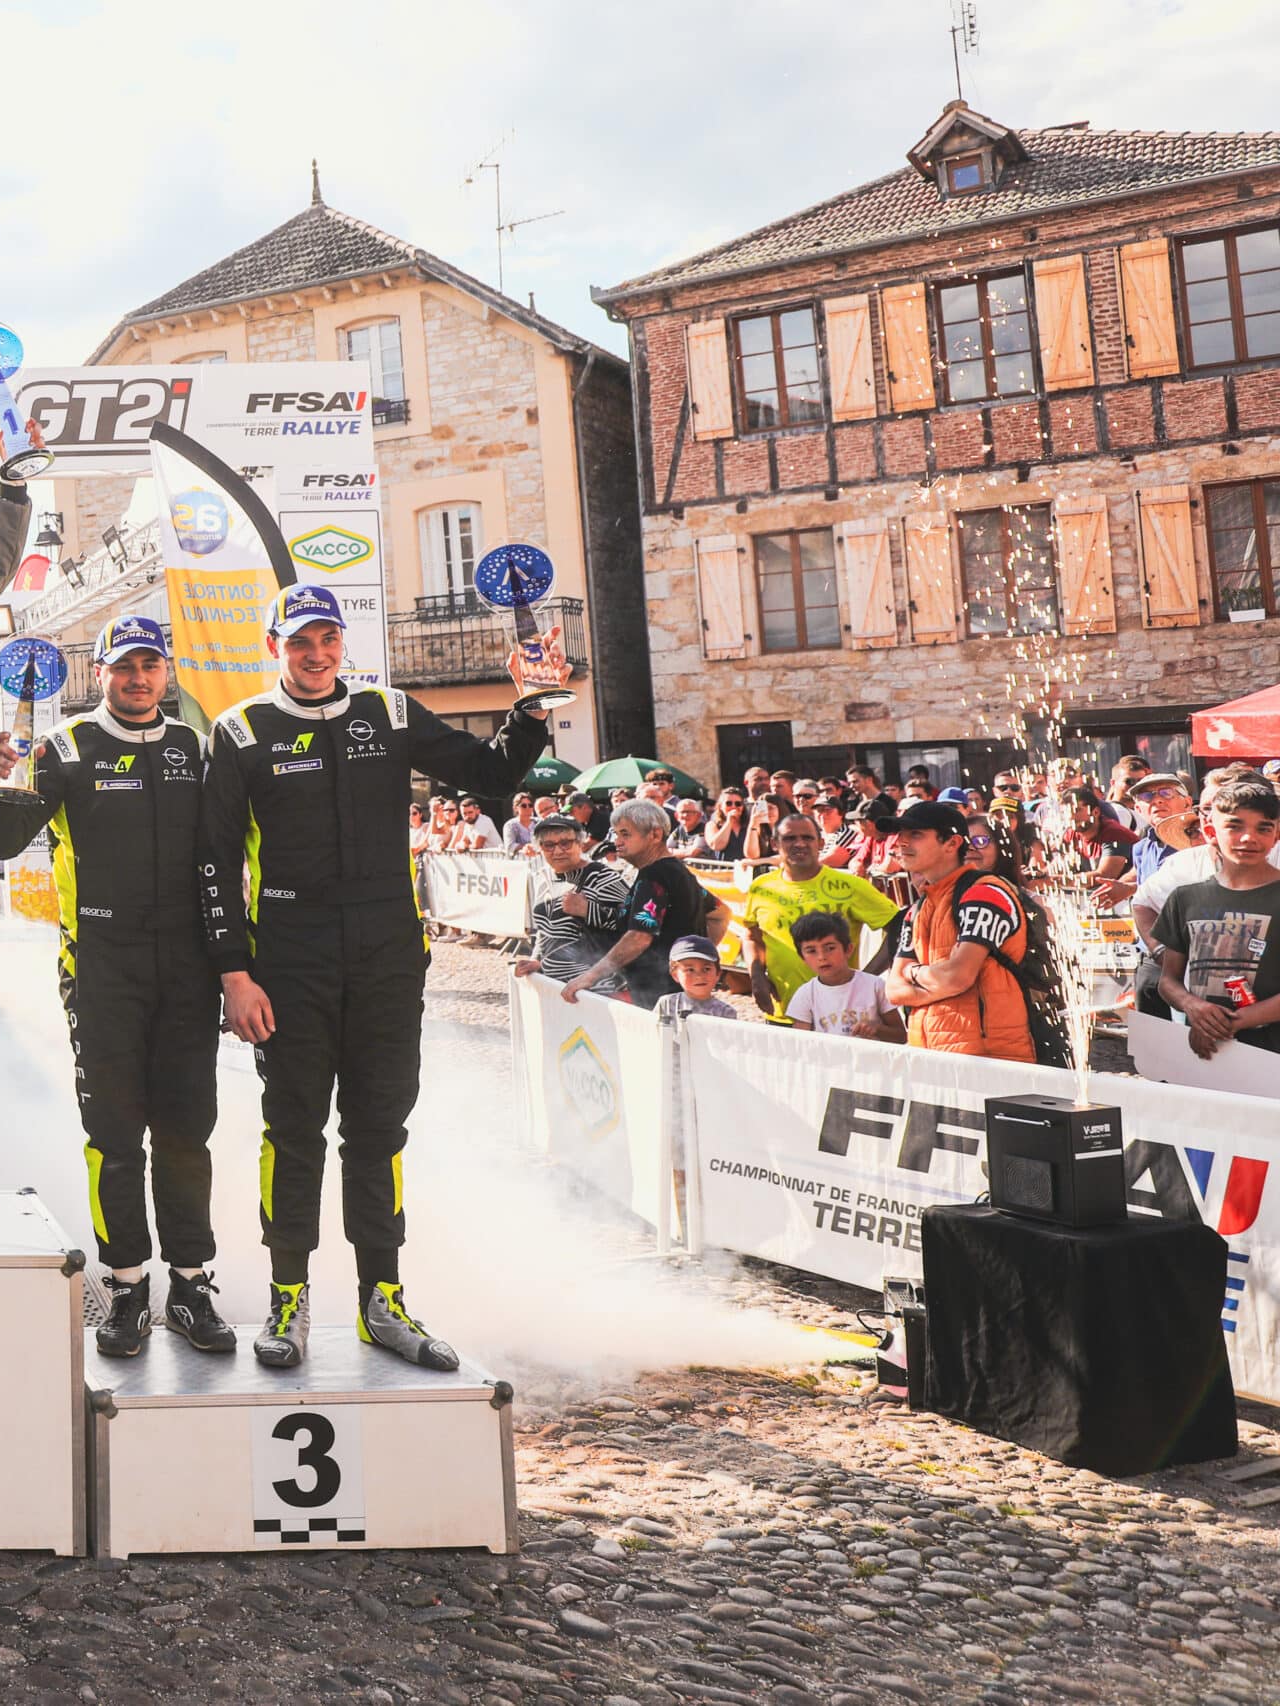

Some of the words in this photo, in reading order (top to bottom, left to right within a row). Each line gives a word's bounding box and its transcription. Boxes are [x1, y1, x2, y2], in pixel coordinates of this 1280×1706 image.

[246, 391, 354, 414] FFSA
[16, 378, 194, 446] GT2i
[2, 408, 19, 435] 1
[244, 427, 279, 437] TERRE
[281, 420, 361, 435] RALLYE
[303, 474, 367, 487] FFSA
[324, 491, 373, 500] RALLYE
[301, 543, 361, 556] YACCO
[285, 601, 330, 616] MICHELIN
[342, 598, 377, 610] TYRE
[112, 632, 157, 645] MICHELIN
[347, 743, 386, 753] OPEL
[163, 768, 195, 778] OPEL
[263, 887, 296, 899] sparco
[456, 872, 503, 897] FFSA
[204, 863, 228, 940] OPEL
[80, 906, 113, 917] sparco
[69, 1011, 92, 1104] OPEL
[819, 1086, 1205, 1226] FFA
[709, 1158, 825, 1196] CHAMPIONNAT
[829, 1186, 851, 1203] DE
[856, 1192, 925, 1219] FRANCE
[812, 1200, 922, 1253] TERRE
[271, 1412, 341, 1508] 3
